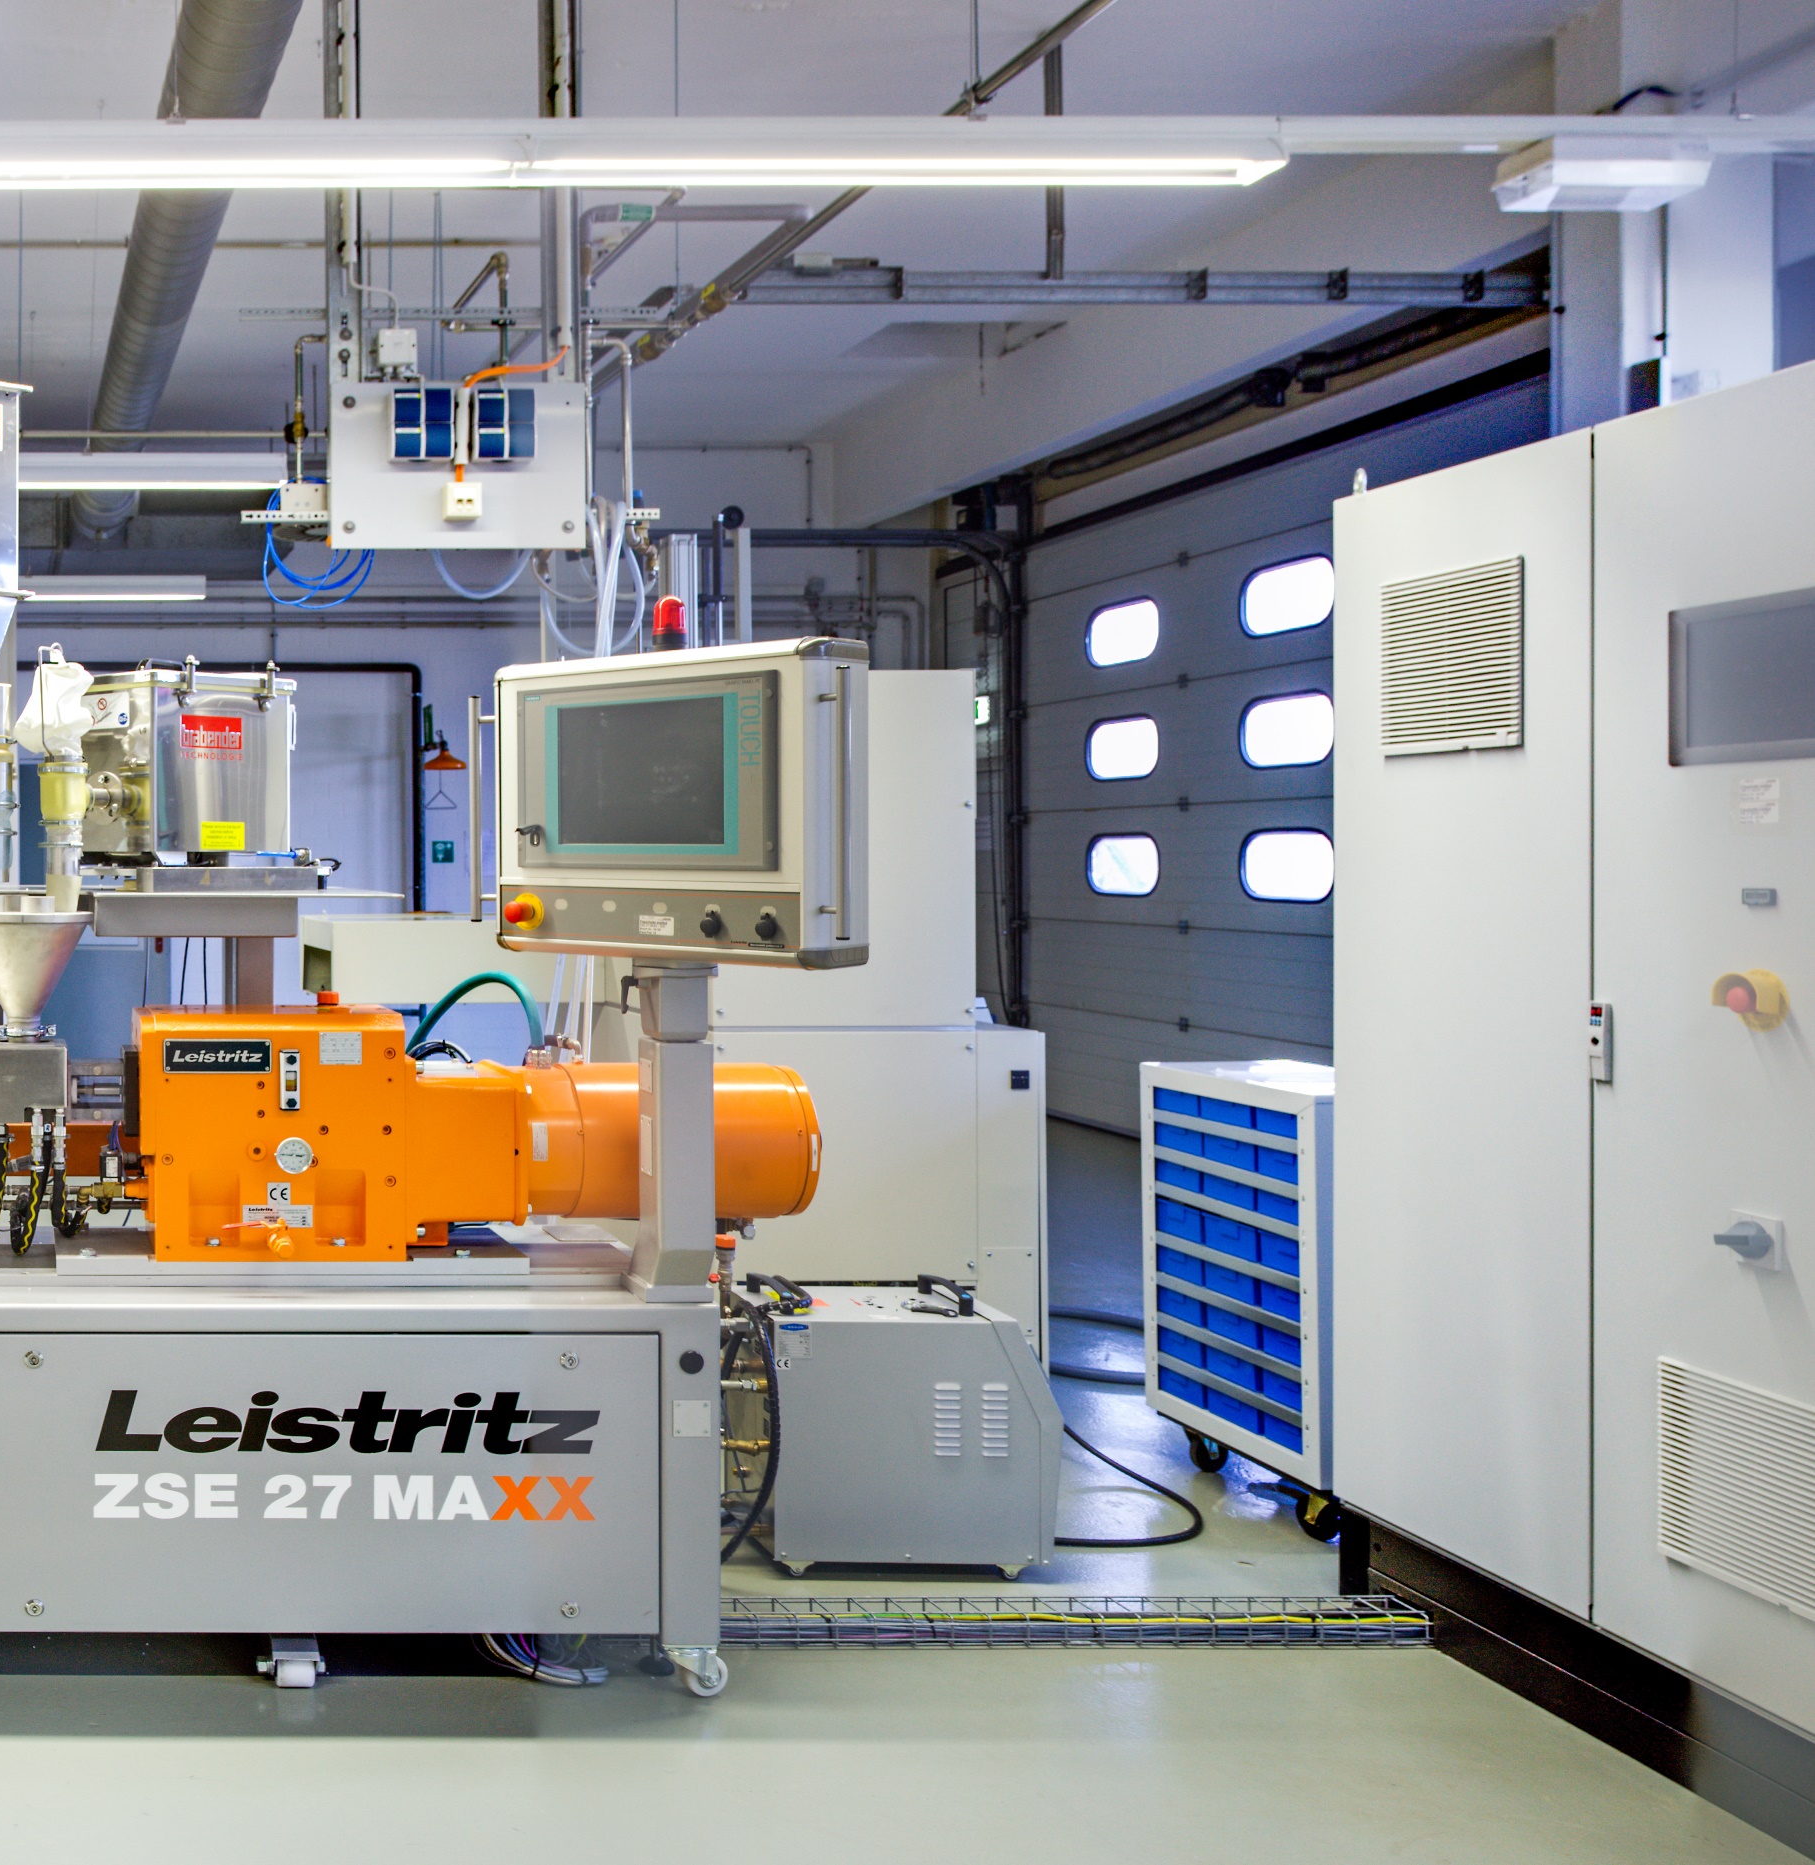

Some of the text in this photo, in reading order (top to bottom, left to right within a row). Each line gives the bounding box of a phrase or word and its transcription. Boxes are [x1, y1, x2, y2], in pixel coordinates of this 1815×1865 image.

[181, 724, 241, 748] brabender
[740, 690, 761, 767] TOUCH
[172, 1050, 263, 1063] Leistritz
[269, 1188, 288, 1200] CE
[776, 1359, 789, 1368] CE
[95, 1390, 600, 1454] Leistritz
[93, 1473, 596, 1521] ZSE 27 MAXX
